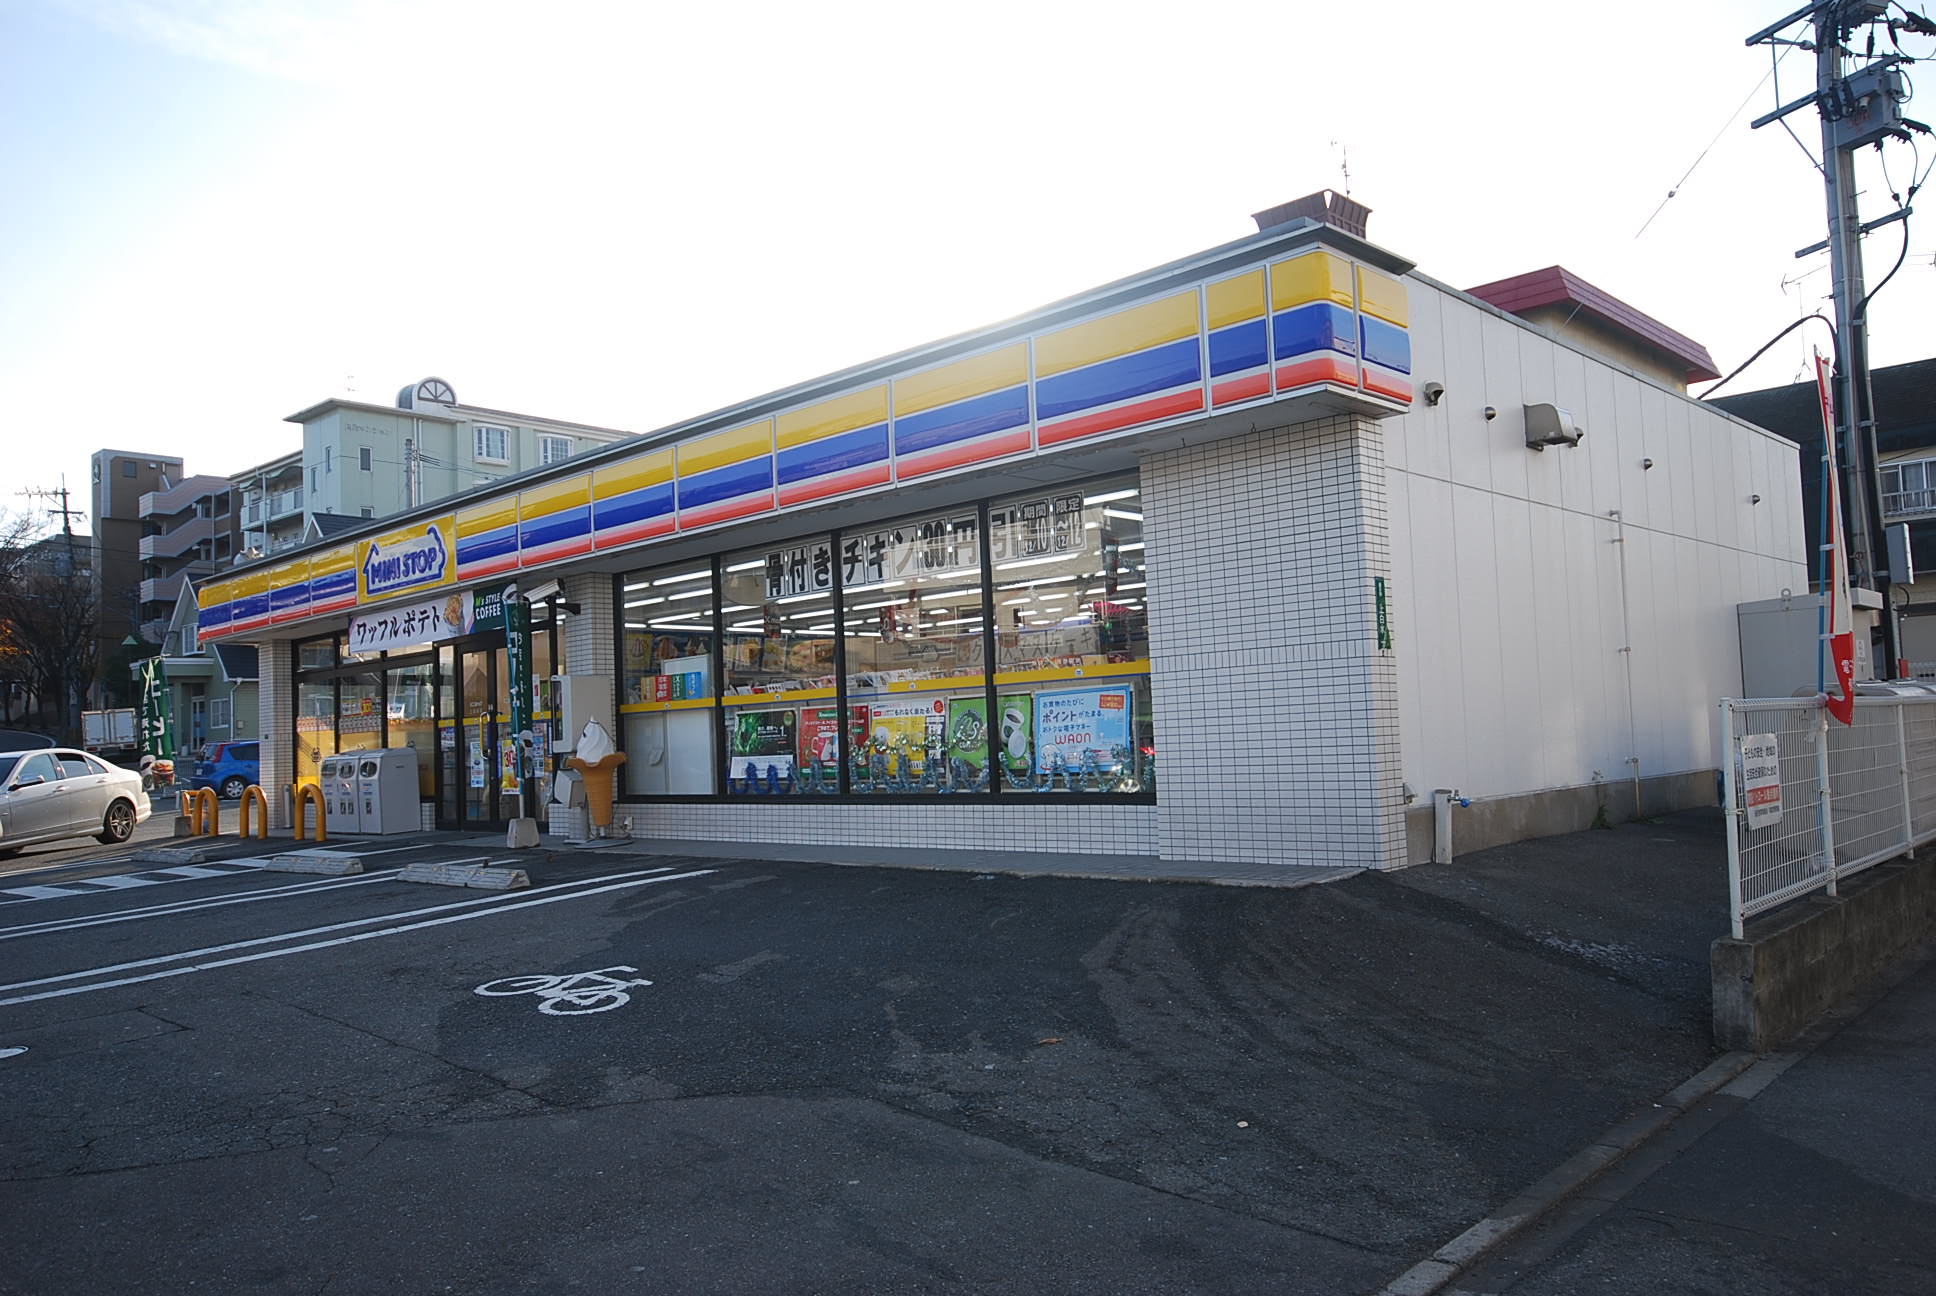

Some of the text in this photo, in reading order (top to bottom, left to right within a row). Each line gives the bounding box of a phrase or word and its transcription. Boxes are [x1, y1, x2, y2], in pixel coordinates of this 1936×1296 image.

[371, 547, 437, 586] MINI STOP
[485, 592, 501, 603] STYLE
[475, 604, 501, 620] COFFEE
[356, 606, 440, 646] ワッフルポテト
[1055, 732, 1091, 745] WAON
